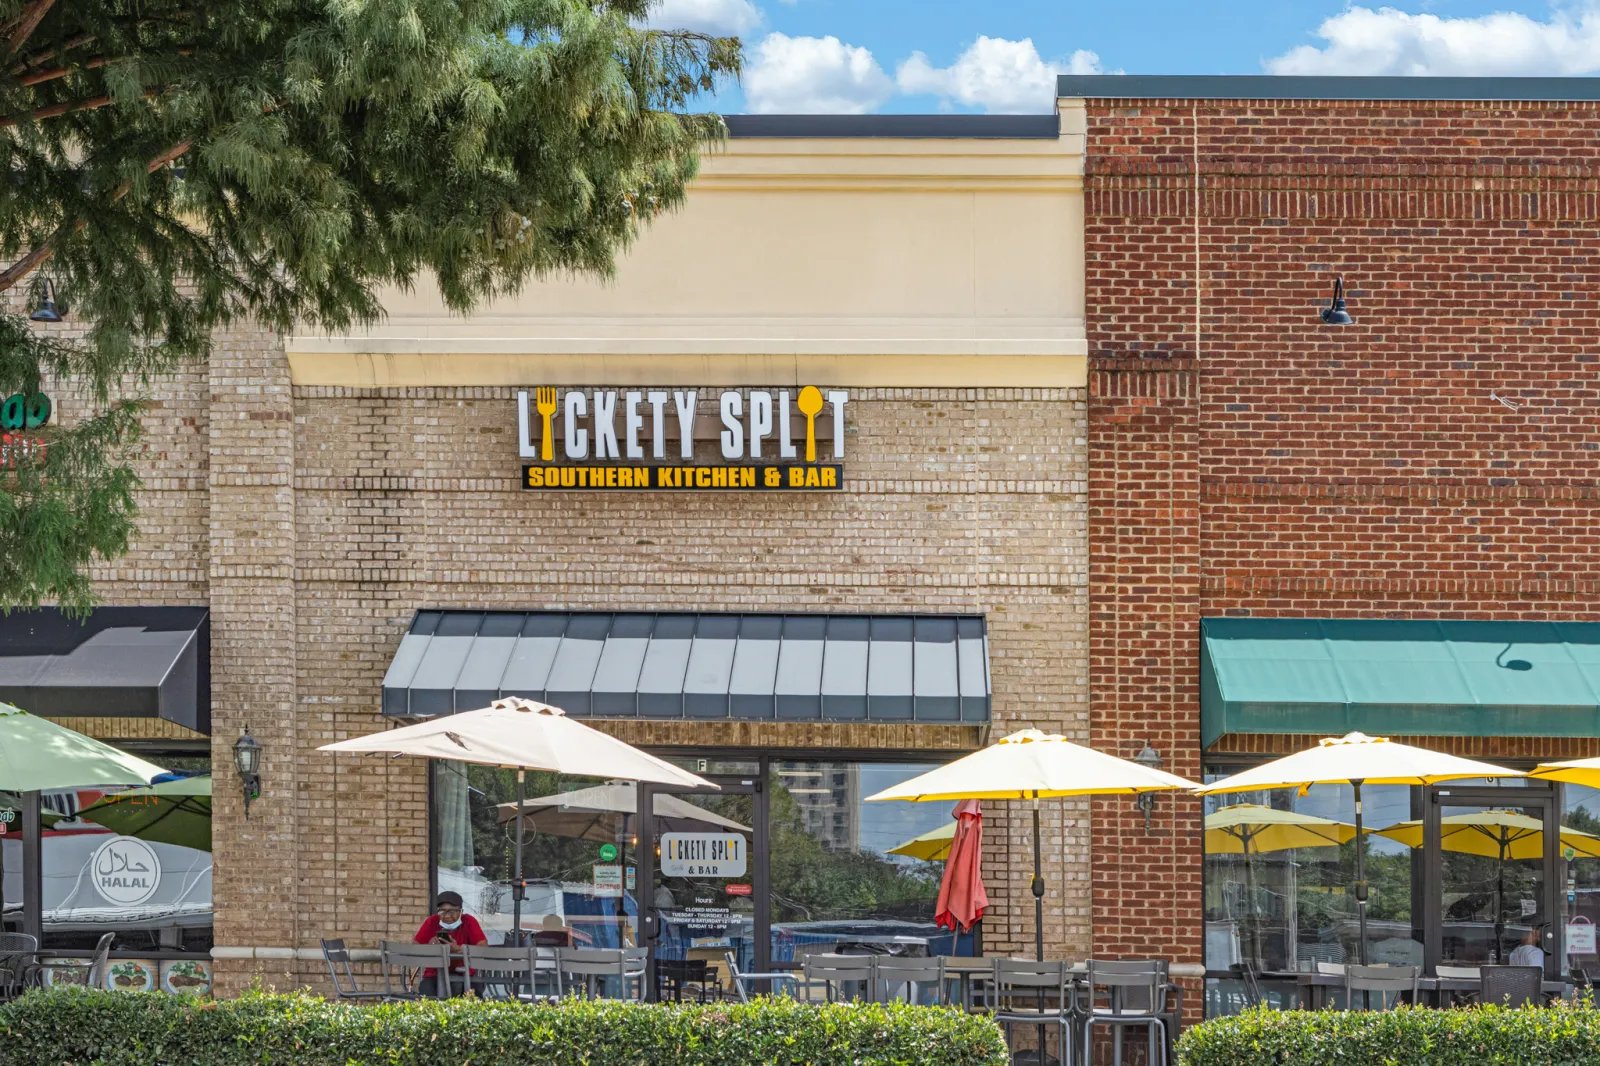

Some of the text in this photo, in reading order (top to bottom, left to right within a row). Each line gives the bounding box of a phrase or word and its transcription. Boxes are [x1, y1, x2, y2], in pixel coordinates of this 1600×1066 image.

[517, 385, 849, 462] LICKETY SPLIT
[528, 466, 837, 488] SOUTHERN KITCHEN & BAR
[698, 760, 706, 771] F
[98, 847, 150, 876] حلال
[688, 866, 695, 874] &
[698, 866, 718, 875] BAR
[101, 877, 150, 888] HALAL
